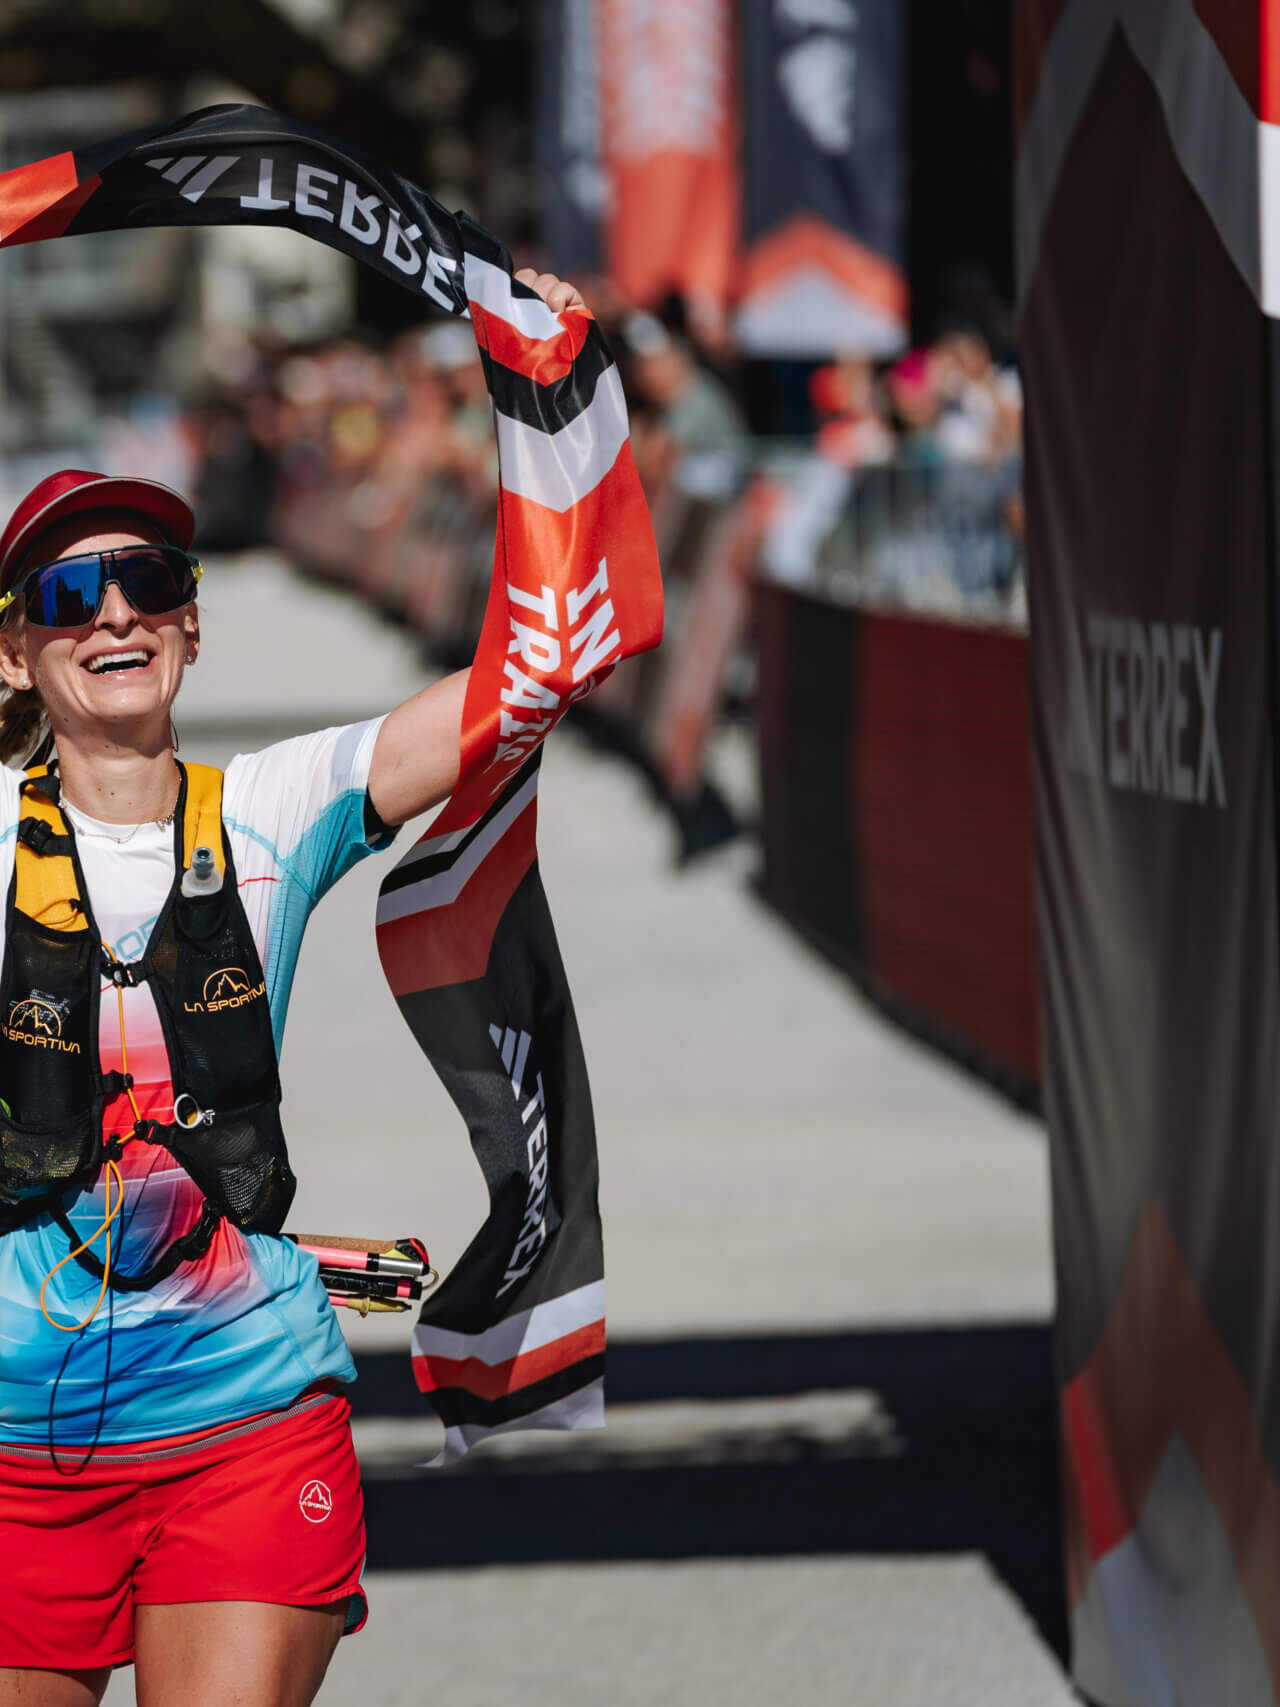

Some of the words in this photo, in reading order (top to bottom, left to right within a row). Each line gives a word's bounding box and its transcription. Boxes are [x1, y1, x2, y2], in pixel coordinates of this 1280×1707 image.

[1085, 616, 1227, 808] TERREX
[8, 1028, 81, 1054] SPORTIVA
[184, 1002, 205, 1012] LA
[495, 1071, 548, 1299] TERREX
